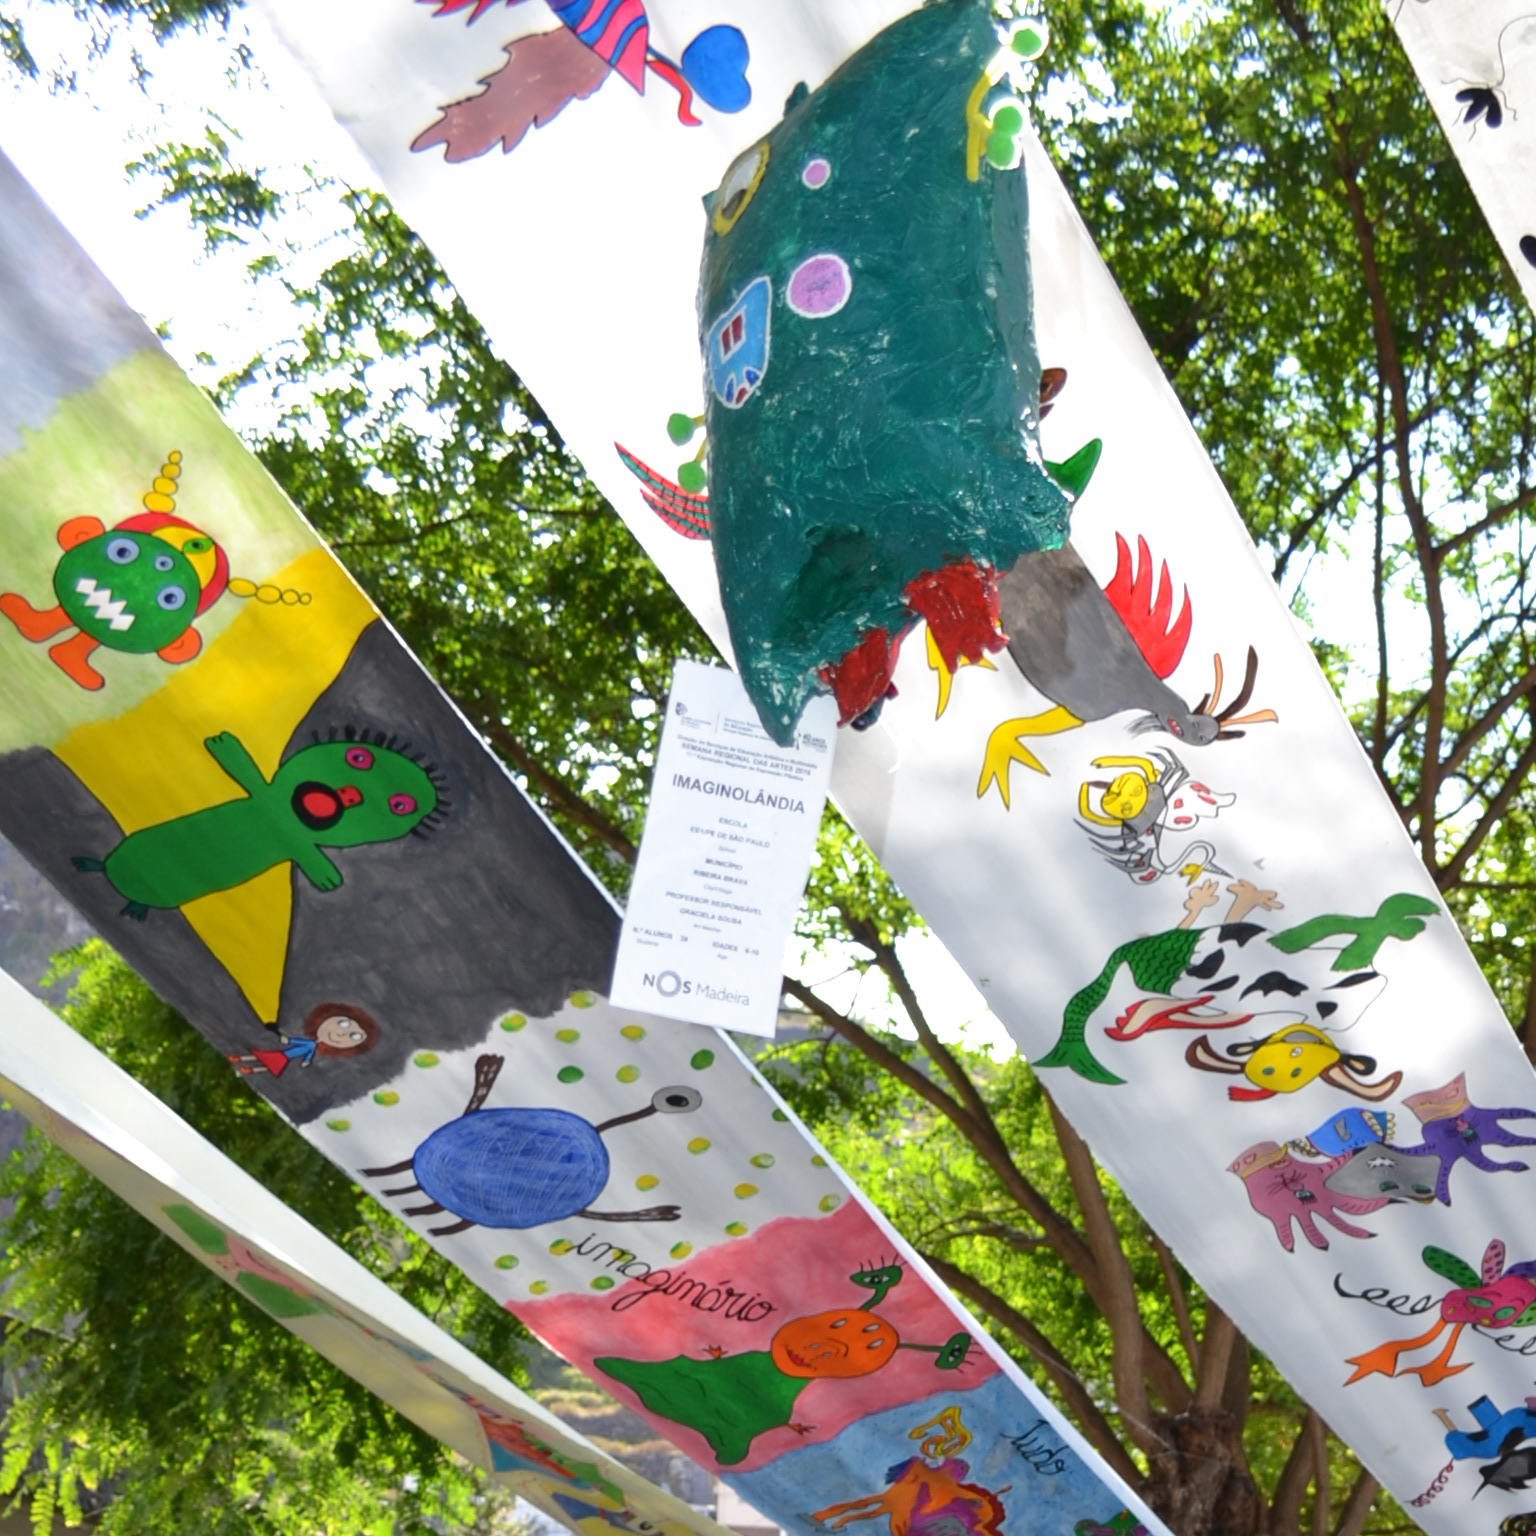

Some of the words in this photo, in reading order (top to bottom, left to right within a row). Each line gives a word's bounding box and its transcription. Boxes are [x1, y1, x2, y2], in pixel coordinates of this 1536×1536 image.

[682, 743, 712, 755] SEMANA
[714, 749, 751, 764] REGIONAL
[753, 758, 768, 767] DAS
[769, 762, 793, 772] ARTES
[672, 773, 805, 814] IMAGINOLÂNDIA
[718, 817, 748, 828] ESCOLA
[745, 837, 770, 848] PAULO
[705, 858, 743, 871] MUNICÍPIO
[693, 869, 722, 880] RIBEIRA
[723, 875, 748, 885] BRAVA
[666, 891, 709, 904] PROFESSOR
[711, 900, 762, 915] RESPONSÁVEL
[680, 908, 716, 920] GRACIELA
[644, 929, 673, 939] ALUNOS
[712, 942, 738, 952] IDADES
[643, 970, 692, 997] NOS
[696, 983, 750, 1006] Madeira
[568, 1232, 777, 1322] imaginário
